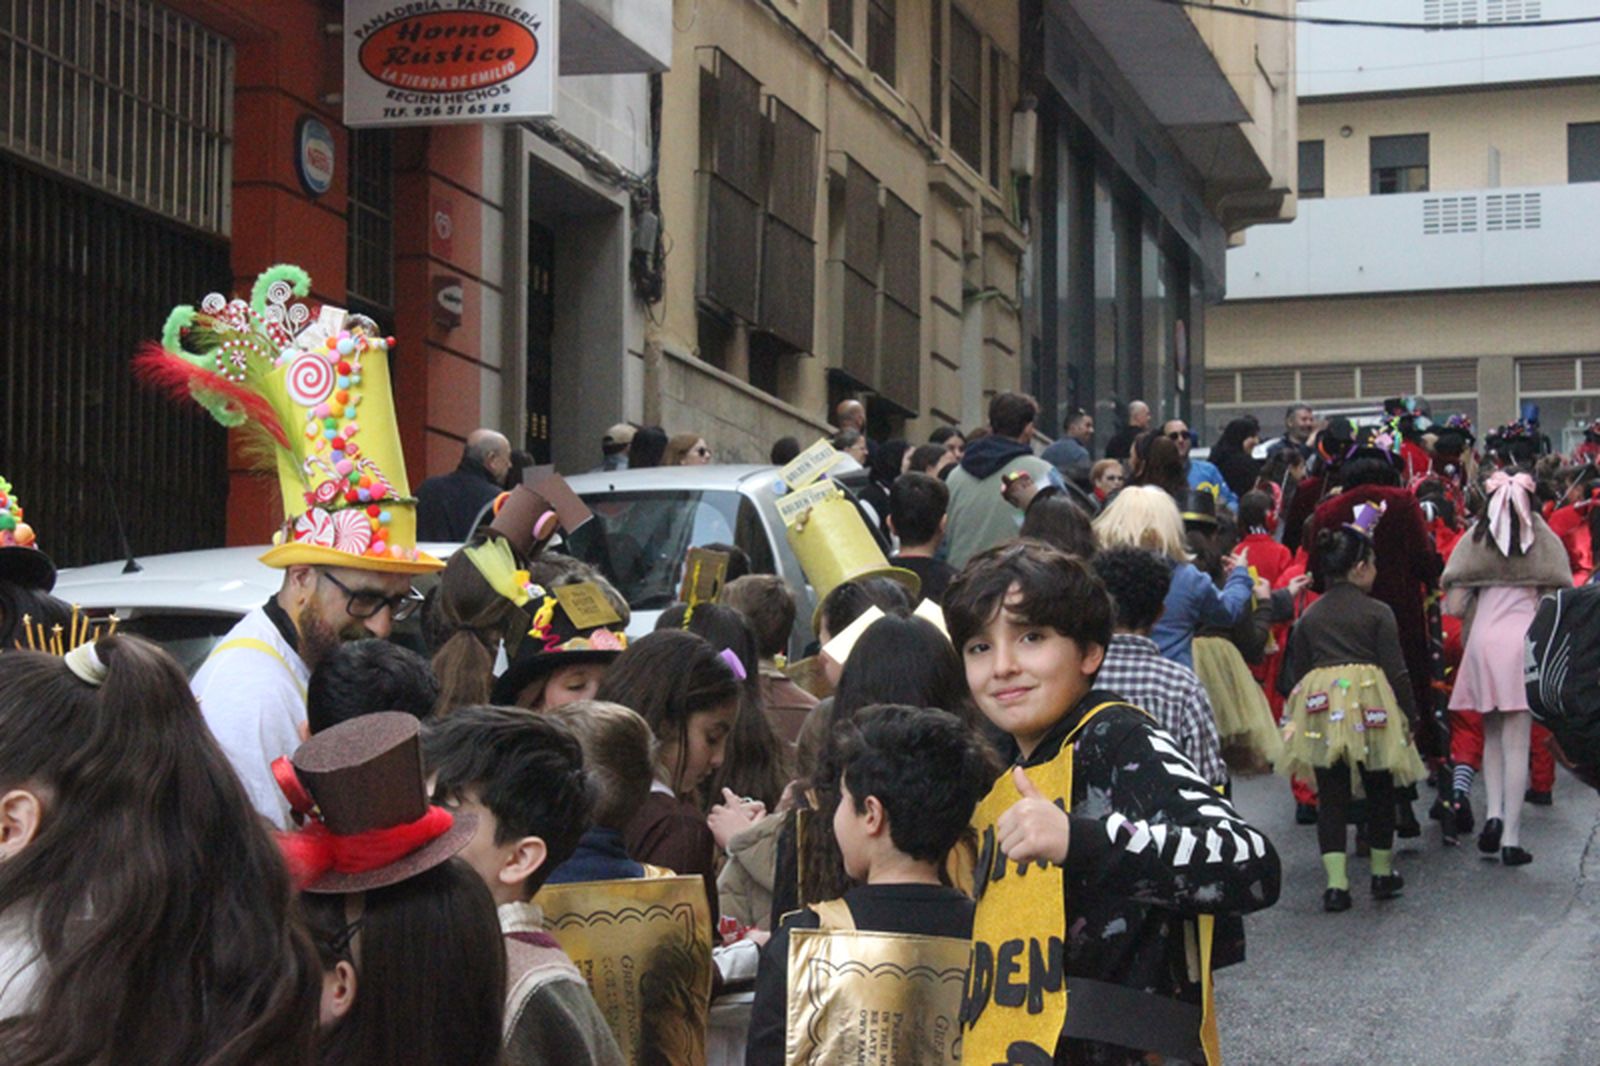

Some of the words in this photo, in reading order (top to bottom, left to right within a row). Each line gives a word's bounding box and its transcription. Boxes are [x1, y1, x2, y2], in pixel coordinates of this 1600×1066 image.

[458, 0, 542, 33] PASTELERÍA
[396, 22, 502, 42] Horno
[381, 67, 398, 82] LA
[399, 73, 447, 89] TIENDA
[450, 75, 466, 88] DE
[471, 61, 516, 85] EMILIO
[386, 89, 441, 104] RECIEN
[444, 84, 511, 104] HECHOS
[413, 106, 442, 116] 956
[446, 105, 463, 115] 51
[467, 104, 486, 114] 65
